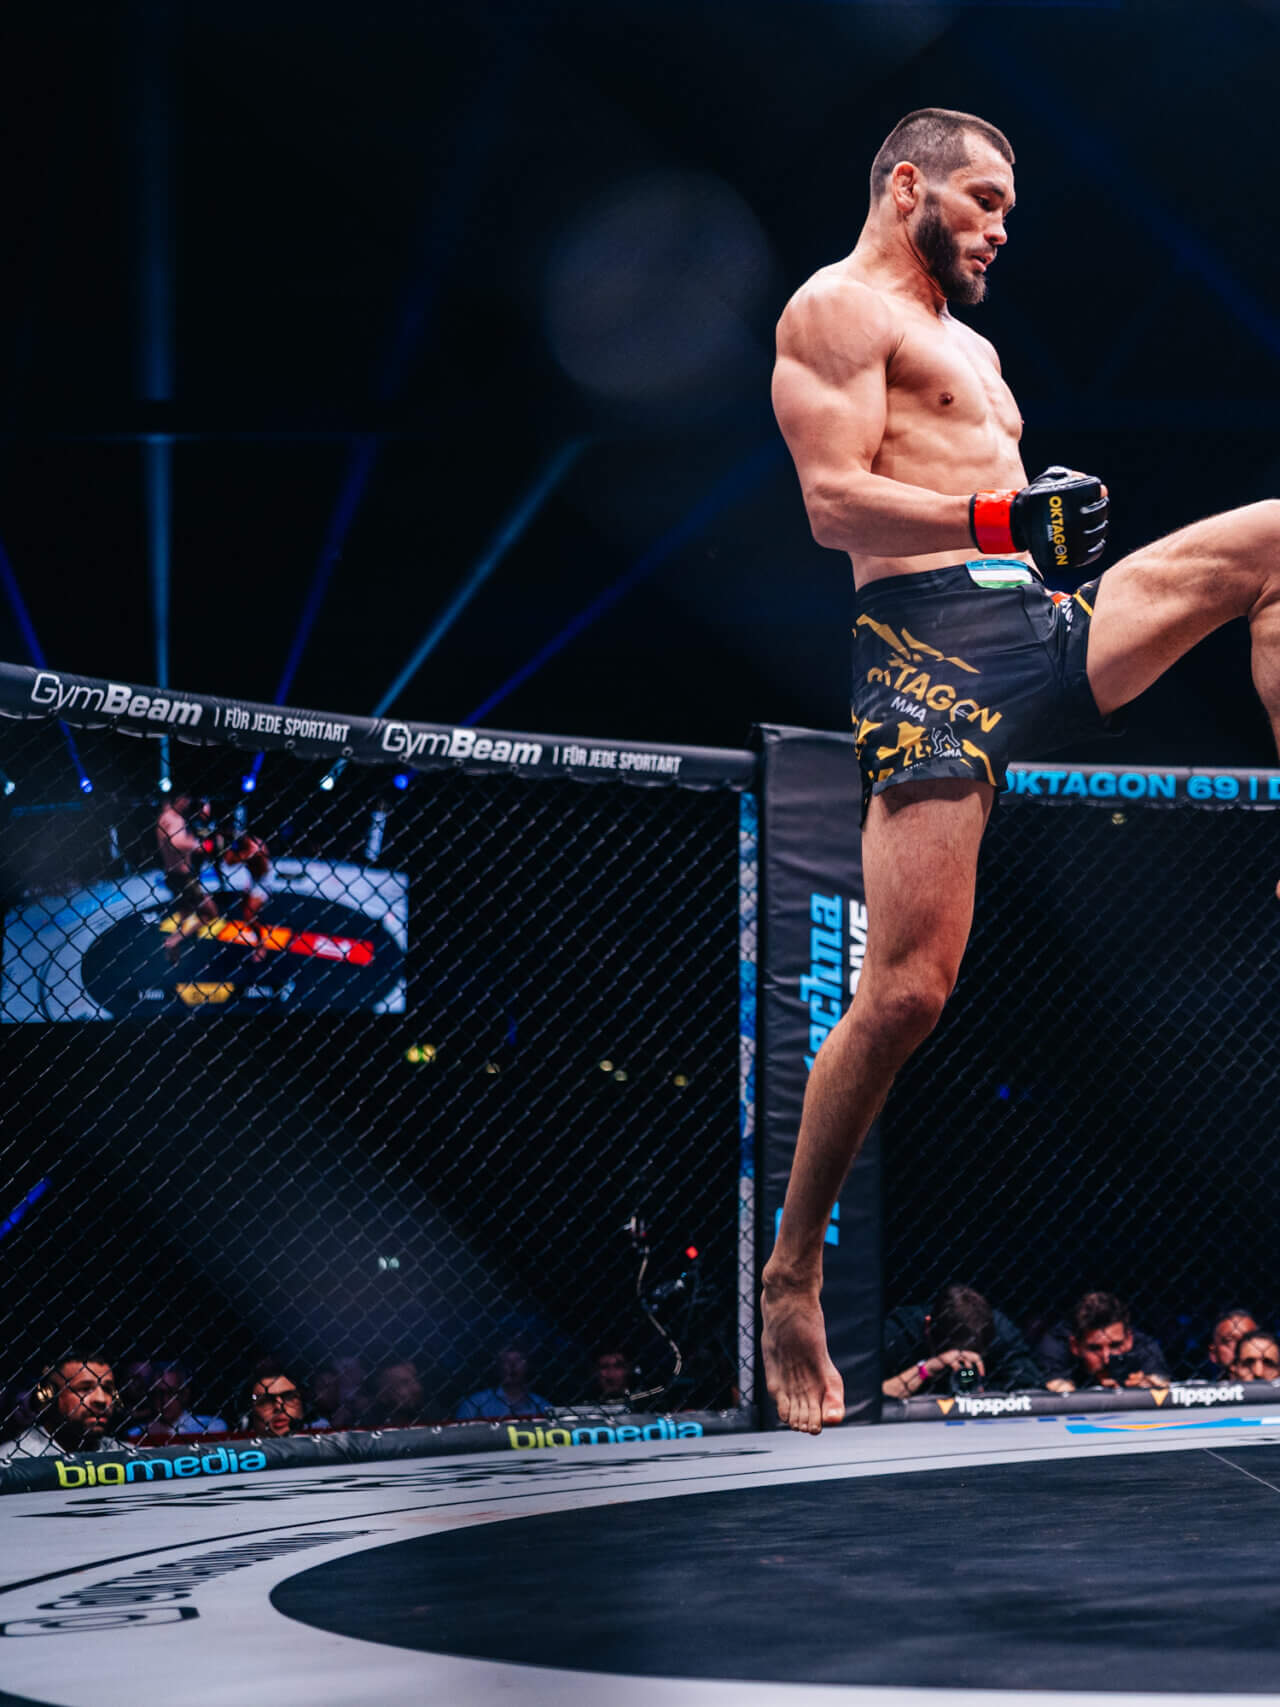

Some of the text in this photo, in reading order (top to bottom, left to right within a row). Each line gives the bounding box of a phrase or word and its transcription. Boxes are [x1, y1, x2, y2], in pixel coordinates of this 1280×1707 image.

[1049, 496, 1069, 566] OKTAGON
[31, 672, 203, 727] GymBeam
[890, 696, 927, 722] MMA
[224, 707, 350, 743] FÜR JEDE SPORTART
[382, 723, 543, 765] GymBeam
[562, 745, 682, 774] FÜR JEDE SPORTART
[1186, 774, 1240, 800] 69
[956, 1395, 1032, 1416] Tipsport
[1170, 1384, 1245, 1406] Tipsport
